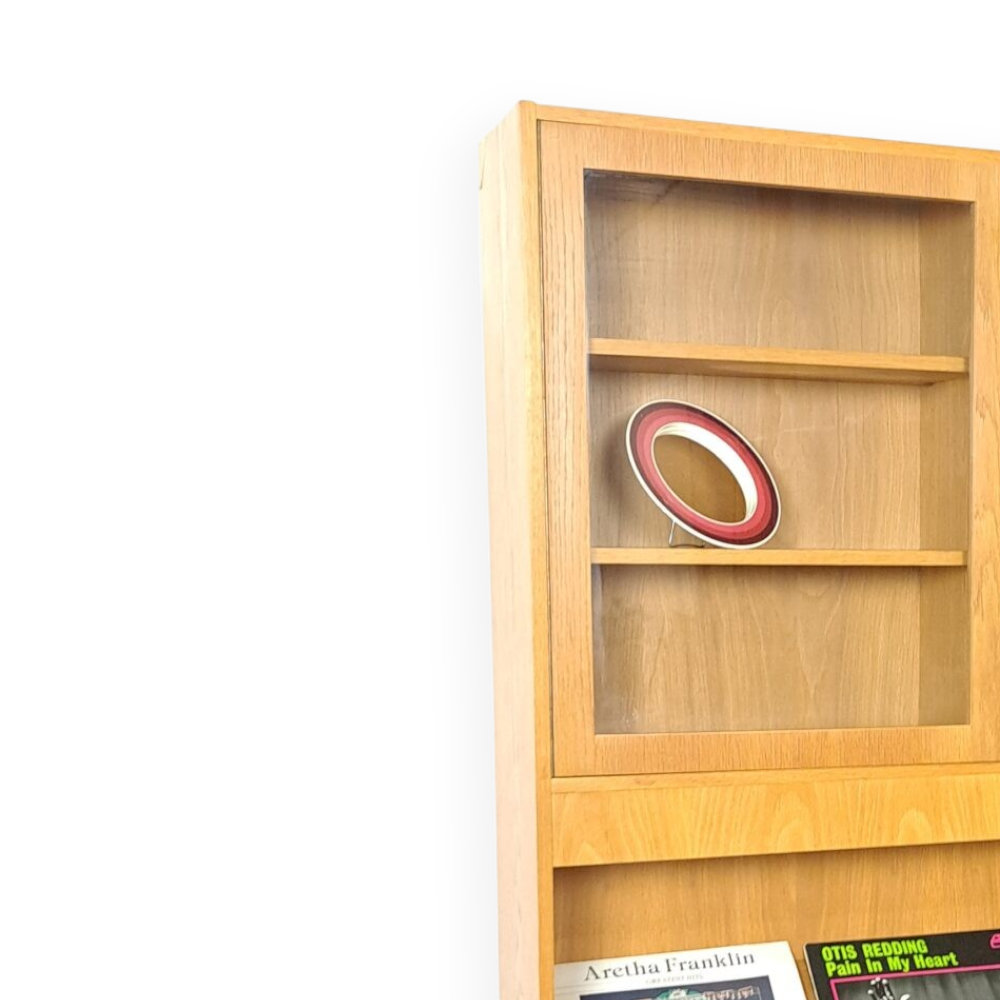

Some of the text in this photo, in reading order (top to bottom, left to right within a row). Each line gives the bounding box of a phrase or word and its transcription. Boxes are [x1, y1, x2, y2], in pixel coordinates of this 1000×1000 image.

[821, 940, 927, 962] OTIS REDDING
[585, 952, 755, 982] Aretha Franklin
[824, 952, 959, 978] Pain In My Heart
